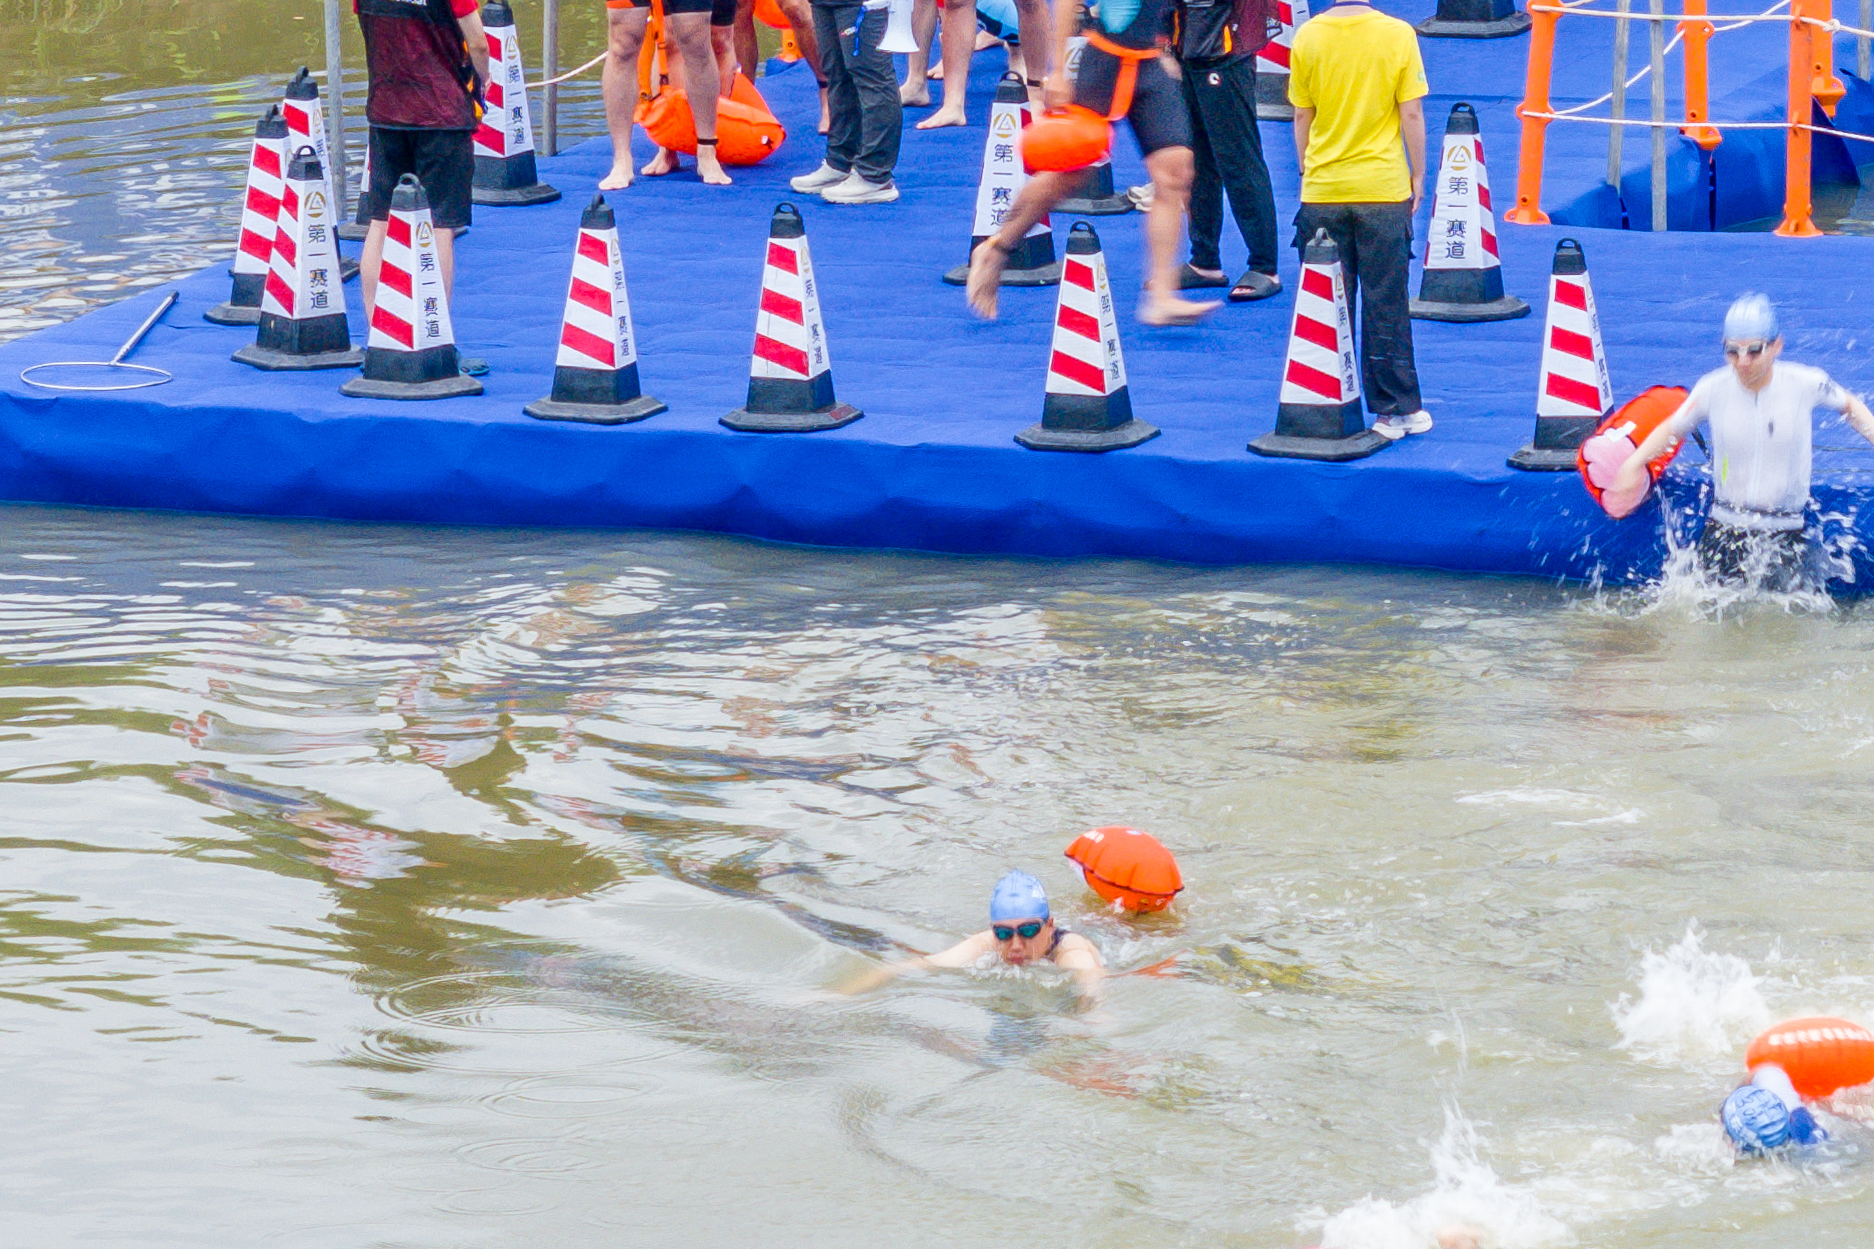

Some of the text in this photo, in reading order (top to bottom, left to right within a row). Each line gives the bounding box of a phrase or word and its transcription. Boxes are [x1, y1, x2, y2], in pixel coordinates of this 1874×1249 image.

[507, 63, 525, 146] 第一赛道
[1445, 176, 1470, 260] 第一赛道
[306, 223, 329, 310] 第一赛道
[419, 252, 442, 339] 第一赛道
